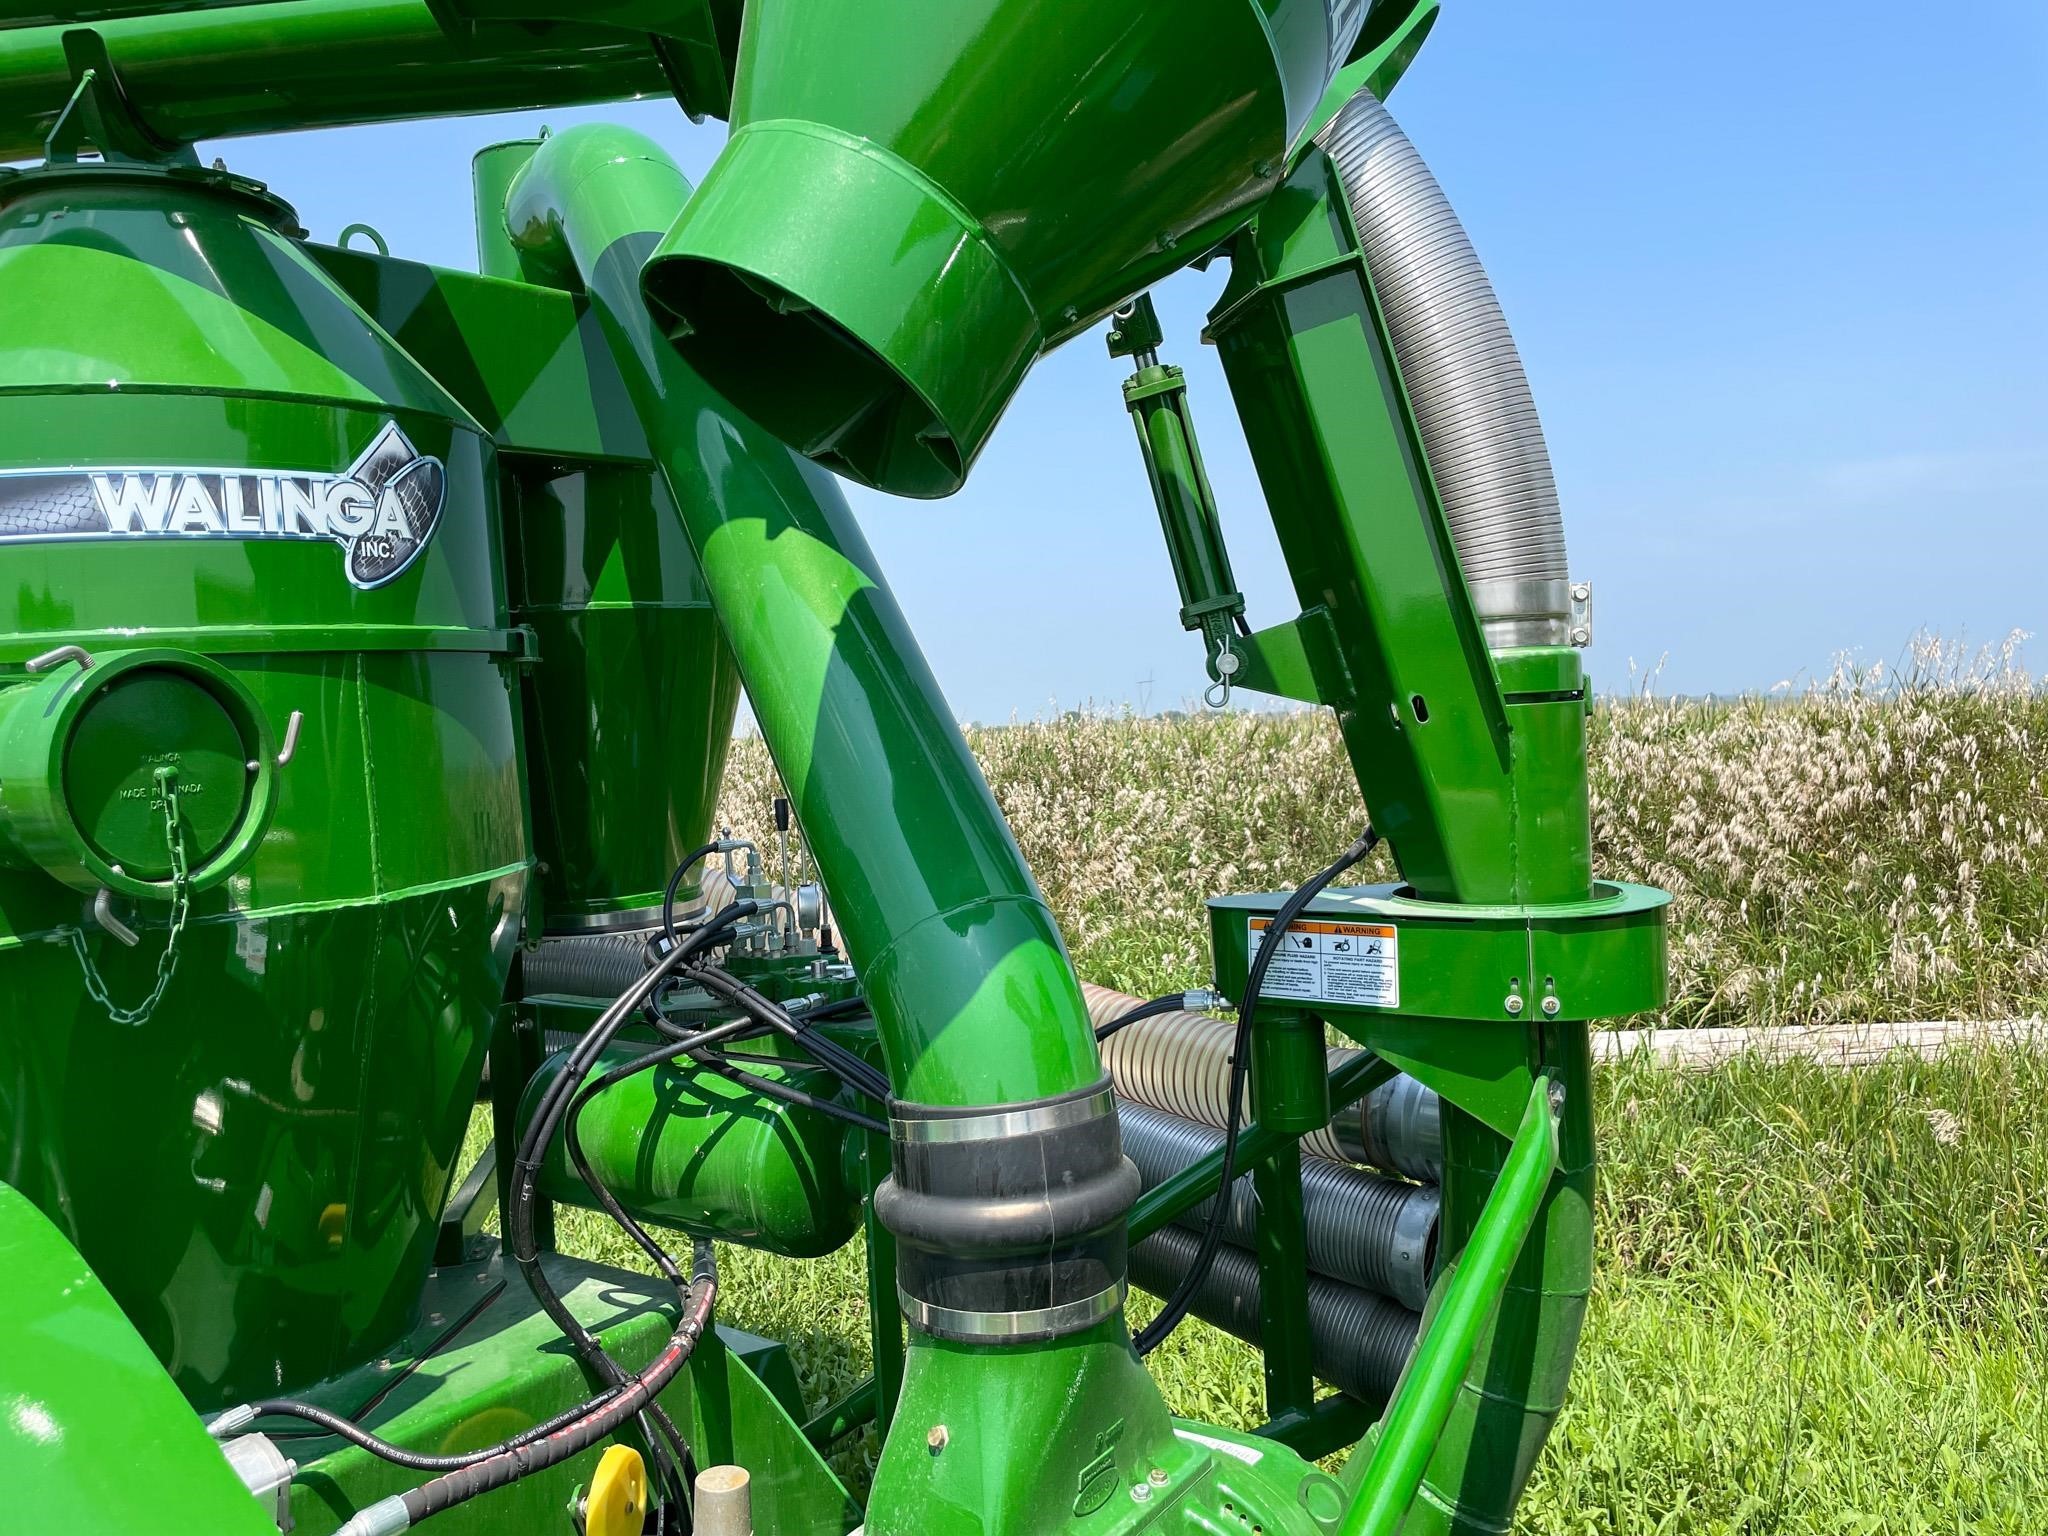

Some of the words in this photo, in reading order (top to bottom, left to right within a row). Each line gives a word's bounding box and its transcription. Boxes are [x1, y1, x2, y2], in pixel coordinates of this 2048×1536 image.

[90, 472, 412, 540] WALINGA
[360, 541, 394, 559] INC.
[120, 787, 146, 799] MADE
[1343, 926, 1381, 935] WARNING
